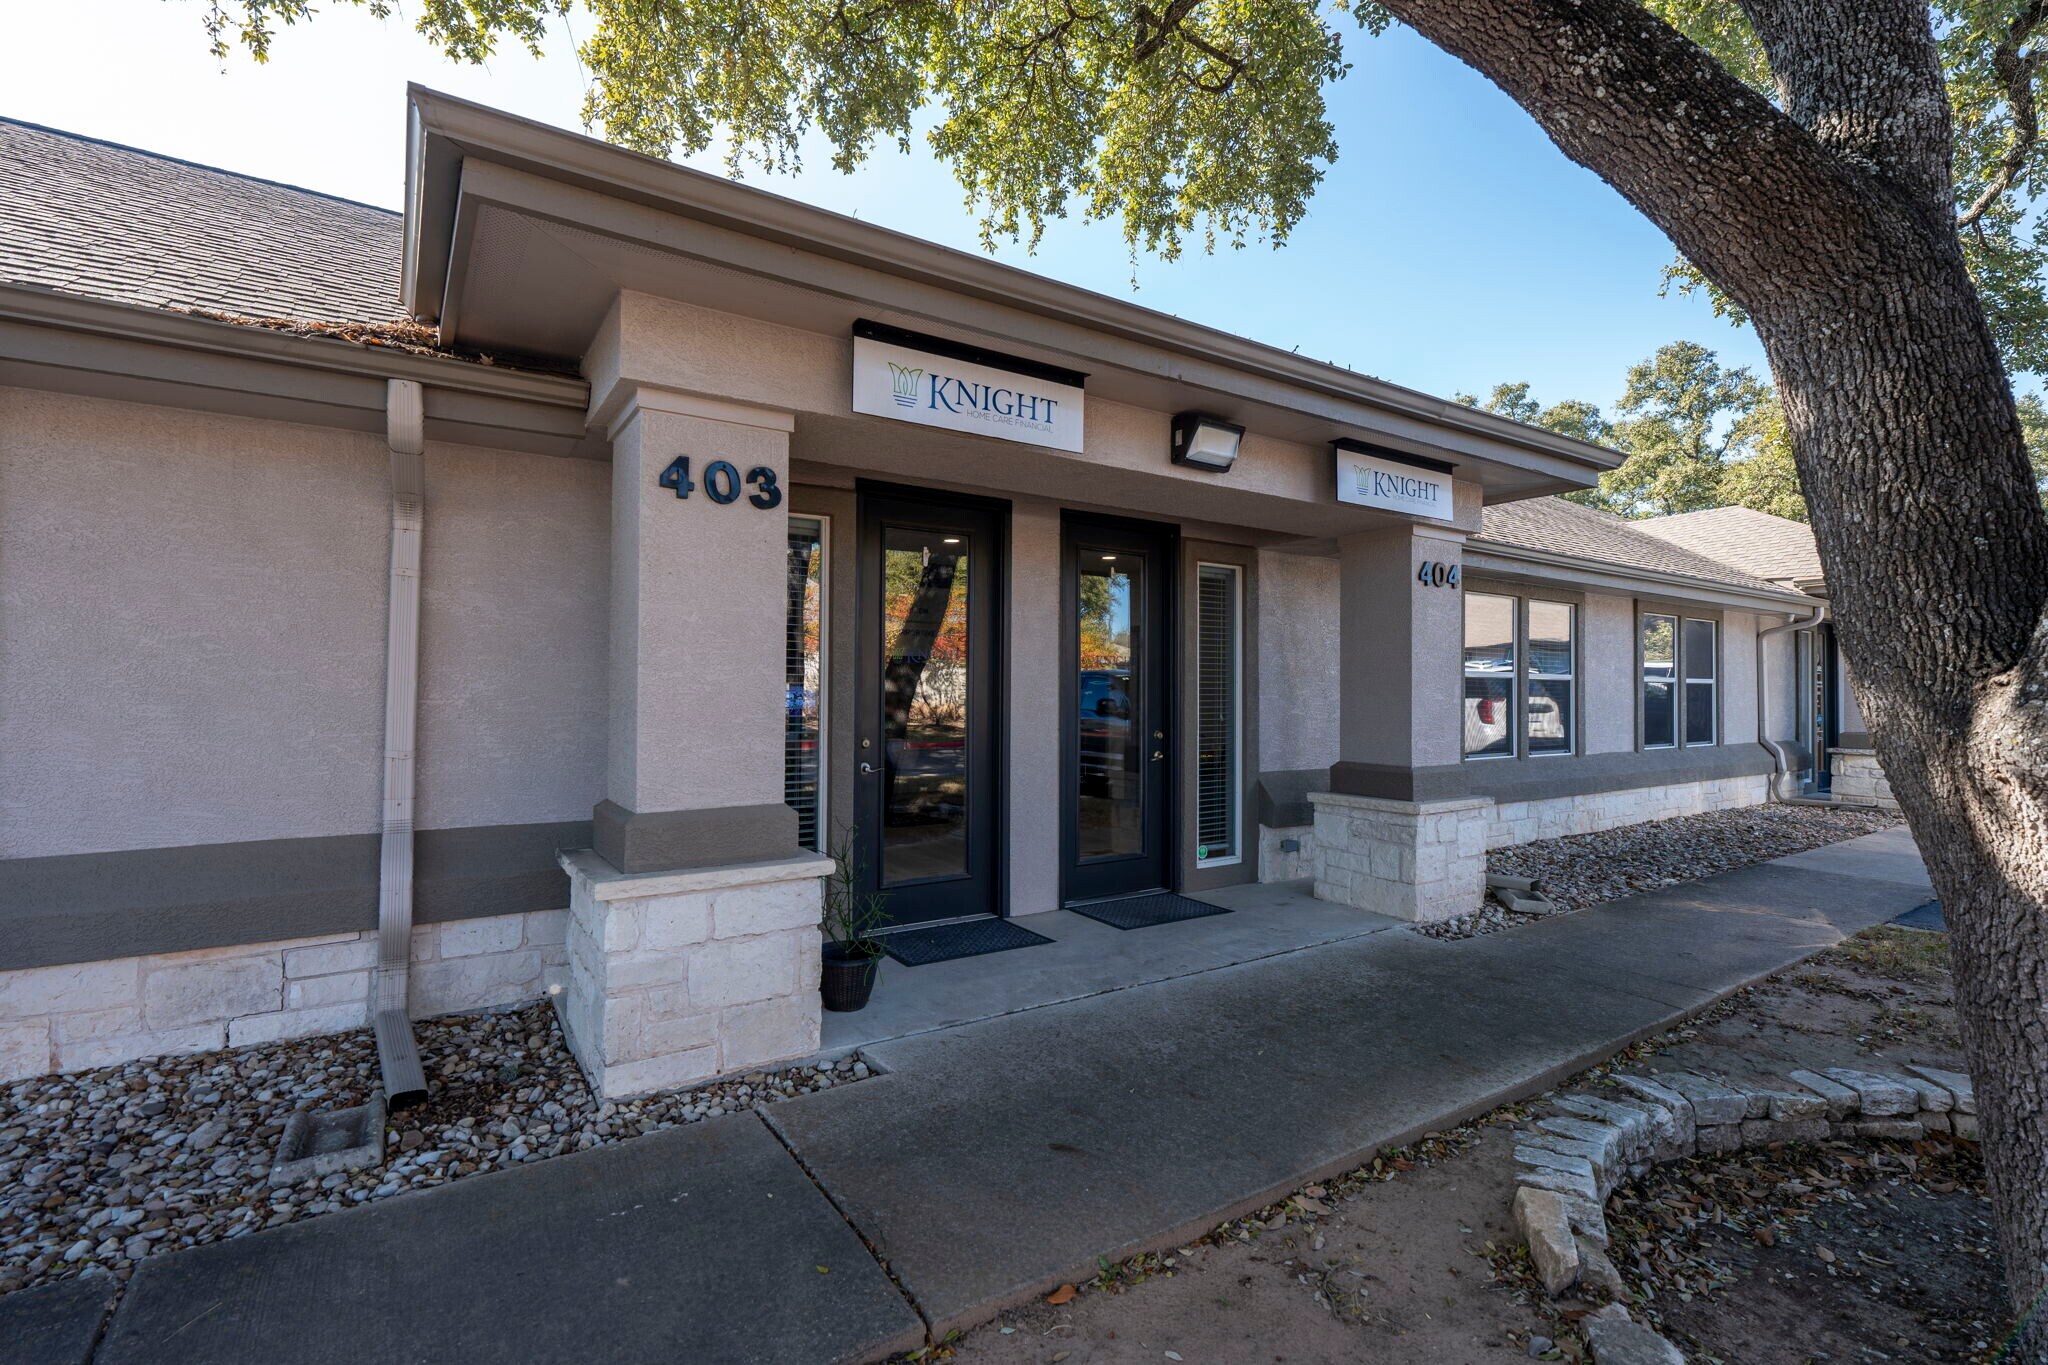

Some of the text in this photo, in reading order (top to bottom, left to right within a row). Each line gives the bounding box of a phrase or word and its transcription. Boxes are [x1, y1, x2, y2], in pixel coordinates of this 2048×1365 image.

[928, 373, 1058, 424] KNIGHT
[966, 409, 1054, 433] HOME CARE FINANCIAL
[659, 455, 782, 510] 403
[1373, 471, 1439, 501] KNIGHT
[1418, 560, 1459, 589] 404
